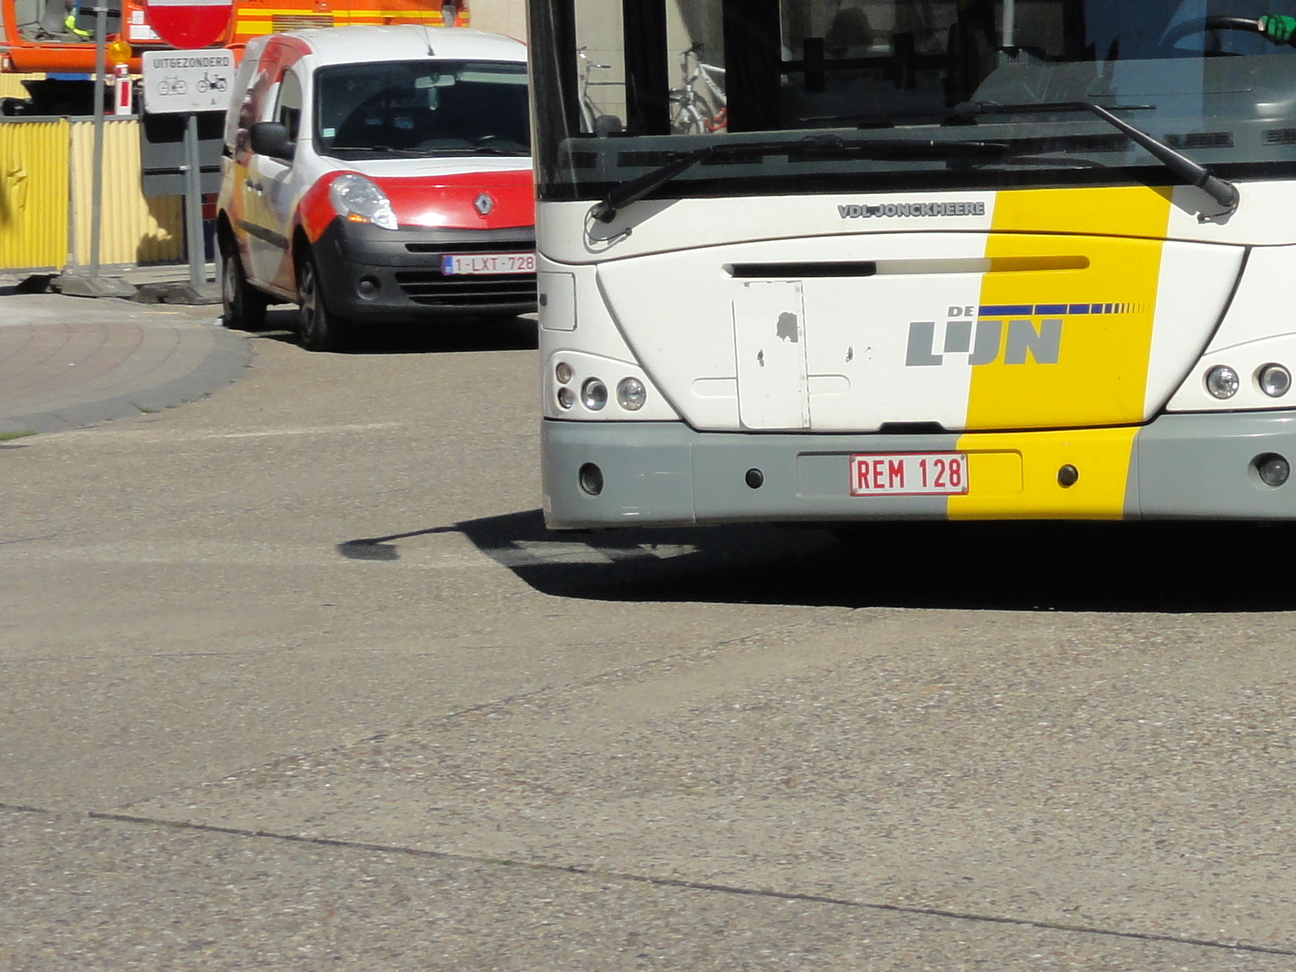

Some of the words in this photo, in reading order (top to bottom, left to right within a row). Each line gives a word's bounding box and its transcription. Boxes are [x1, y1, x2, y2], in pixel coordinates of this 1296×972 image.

[152, 56, 230, 69] UITGEZONDERD
[838, 204, 870, 219] VDL
[874, 201, 986, 217] JONCKHEERE
[455, 255, 535, 272] 1-LXT-728
[947, 305, 975, 318] DE
[904, 318, 1064, 367] LIJN
[857, 459, 905, 489] REM
[918, 458, 962, 488] 128
